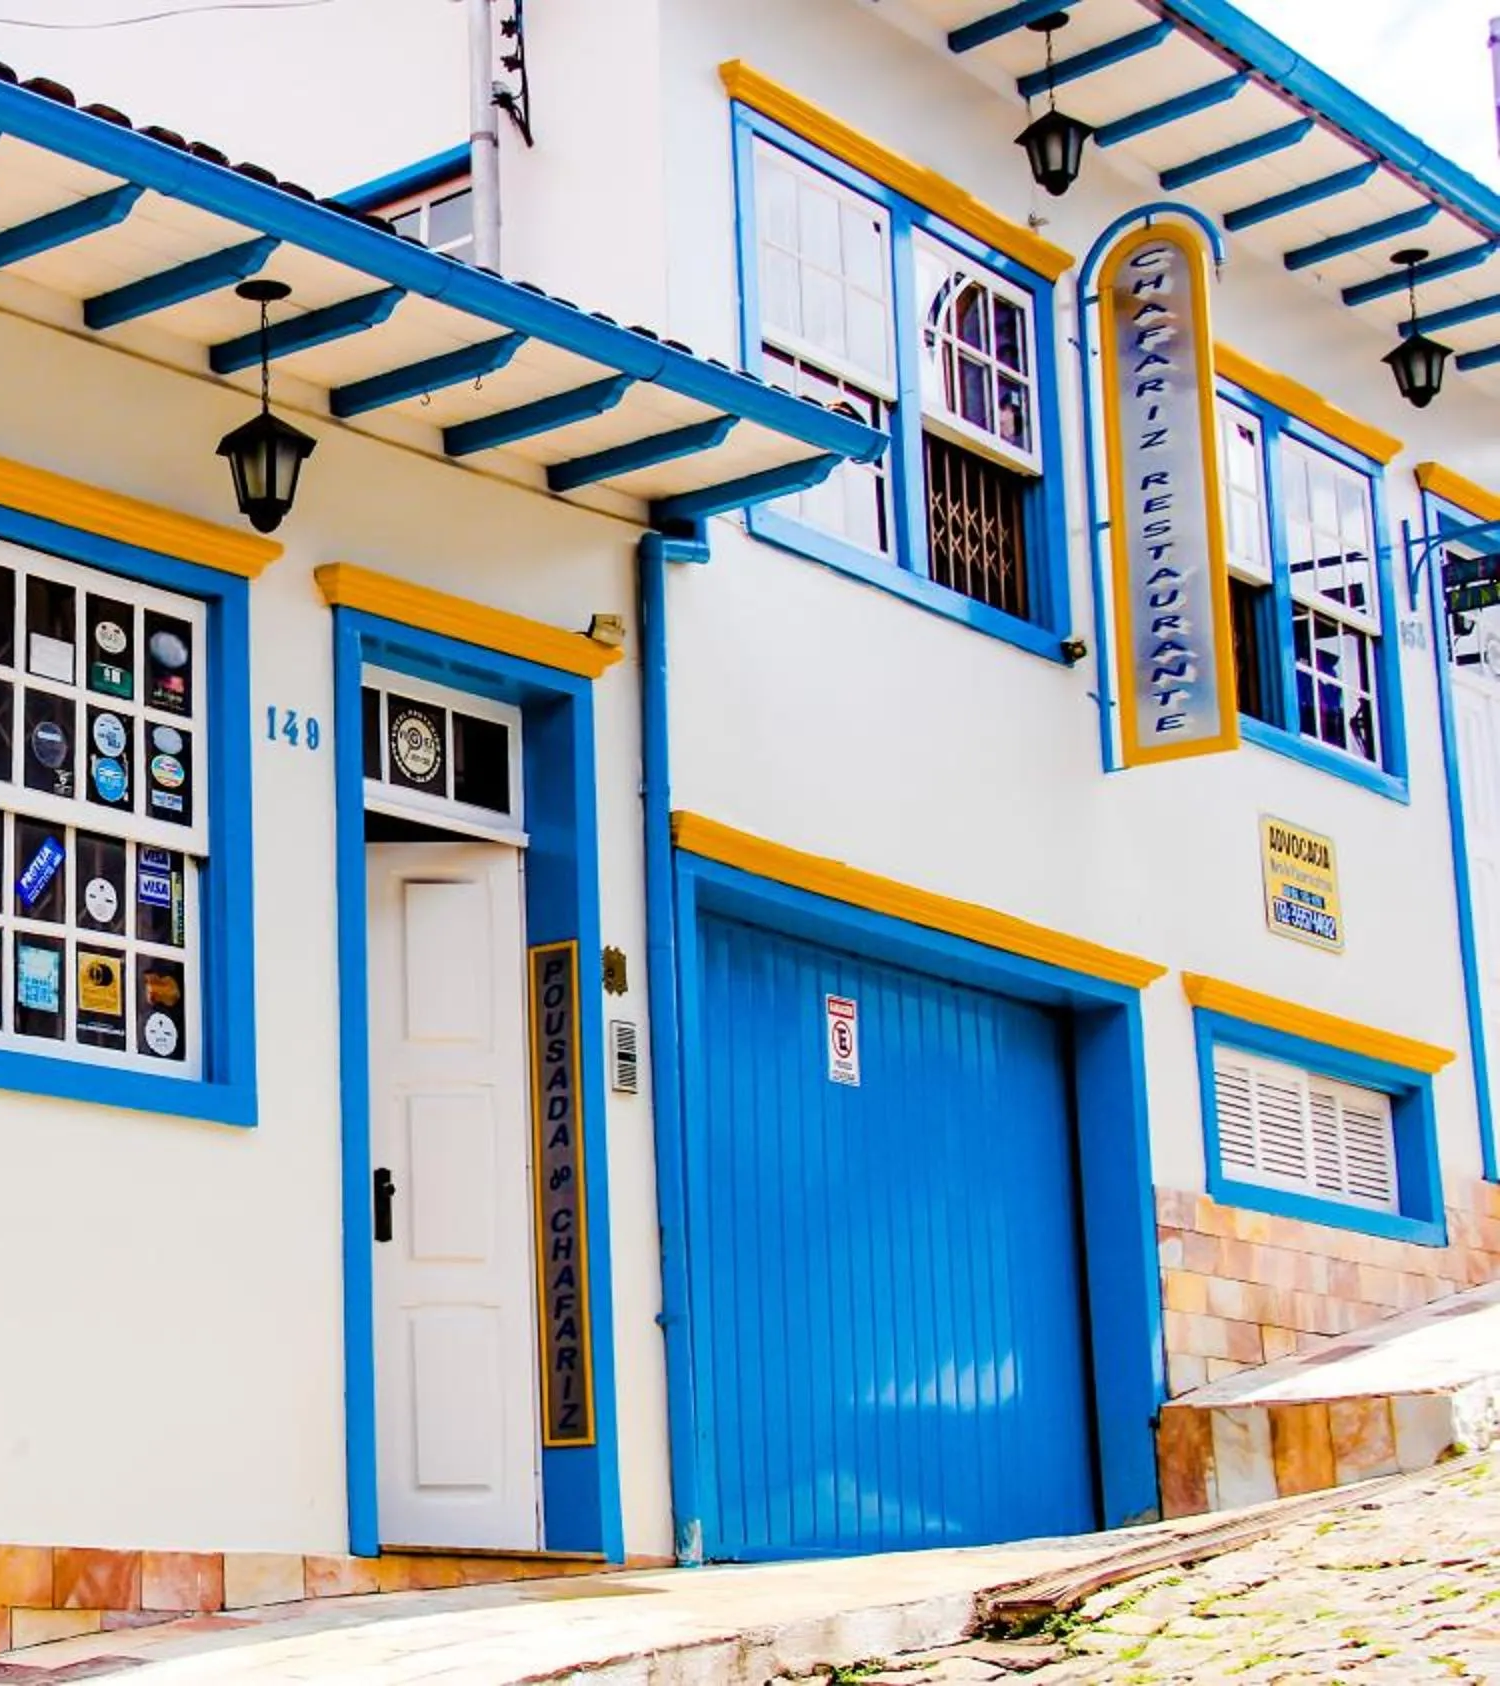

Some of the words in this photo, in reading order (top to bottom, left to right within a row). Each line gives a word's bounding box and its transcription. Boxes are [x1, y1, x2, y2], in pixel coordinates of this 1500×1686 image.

[1130, 247, 1171, 450] CHAFARIZ
[1140, 471, 1188, 733] RESTAURANTE
[266, 705, 319, 751] 149
[143, 880, 169, 896] VISA
[543, 959, 570, 1149] POUSADA
[551, 1209, 578, 1430] CHAFARIZ
